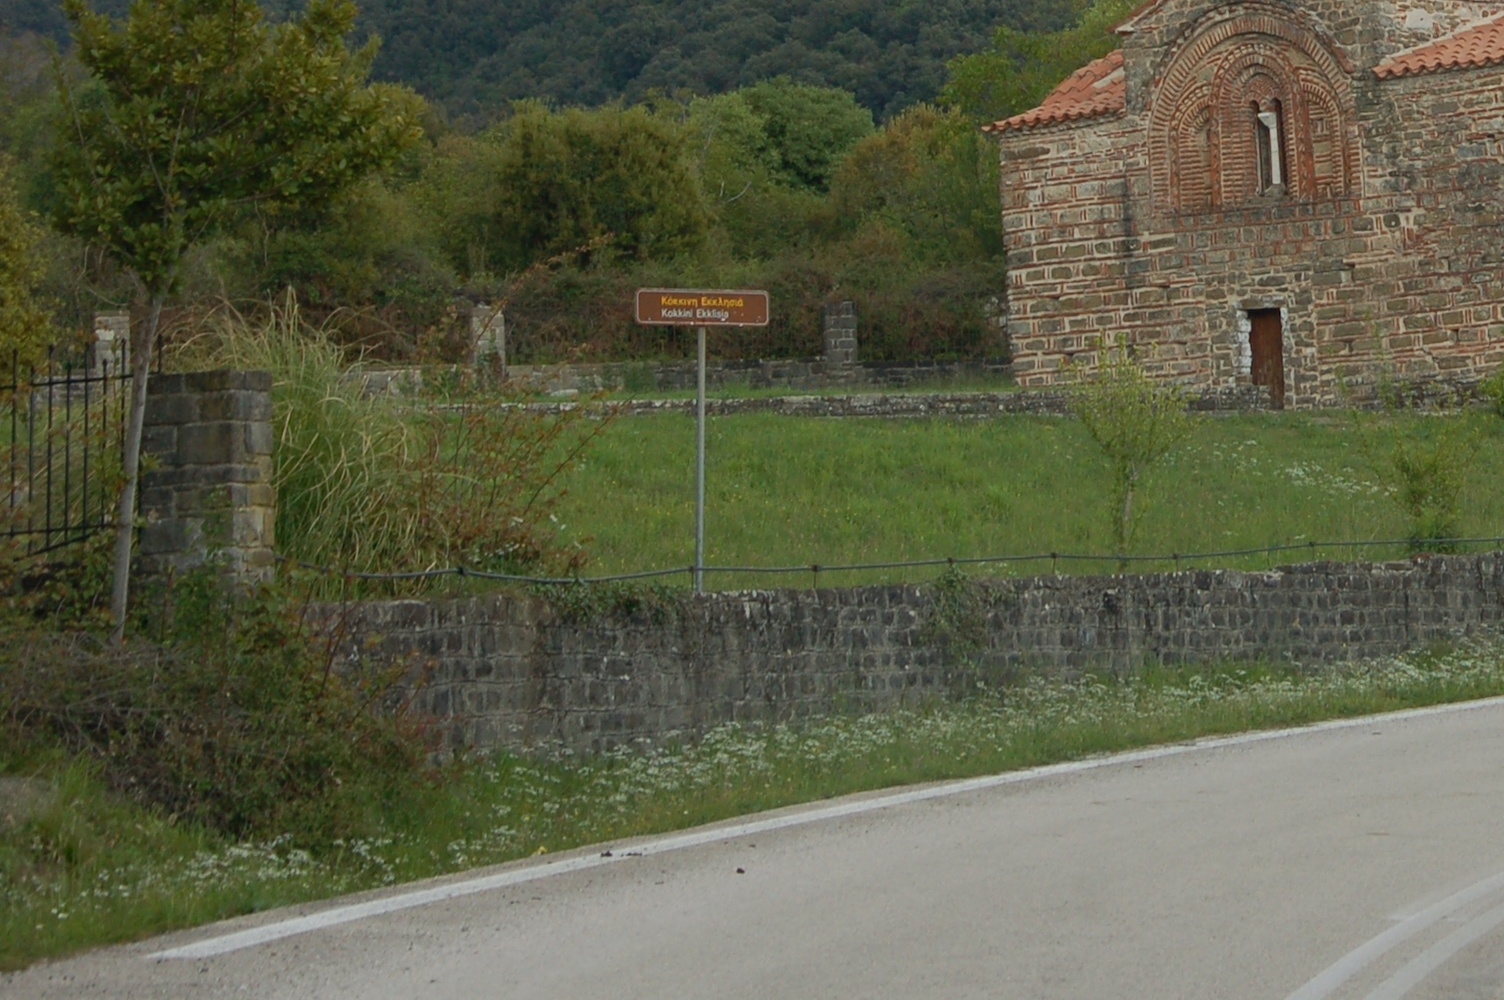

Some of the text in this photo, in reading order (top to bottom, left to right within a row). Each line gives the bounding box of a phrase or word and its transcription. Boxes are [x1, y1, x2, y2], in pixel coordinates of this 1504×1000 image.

[661, 296, 698, 307] Κόκκινη
[661, 308, 729, 318] Kokkini Ekklisia
